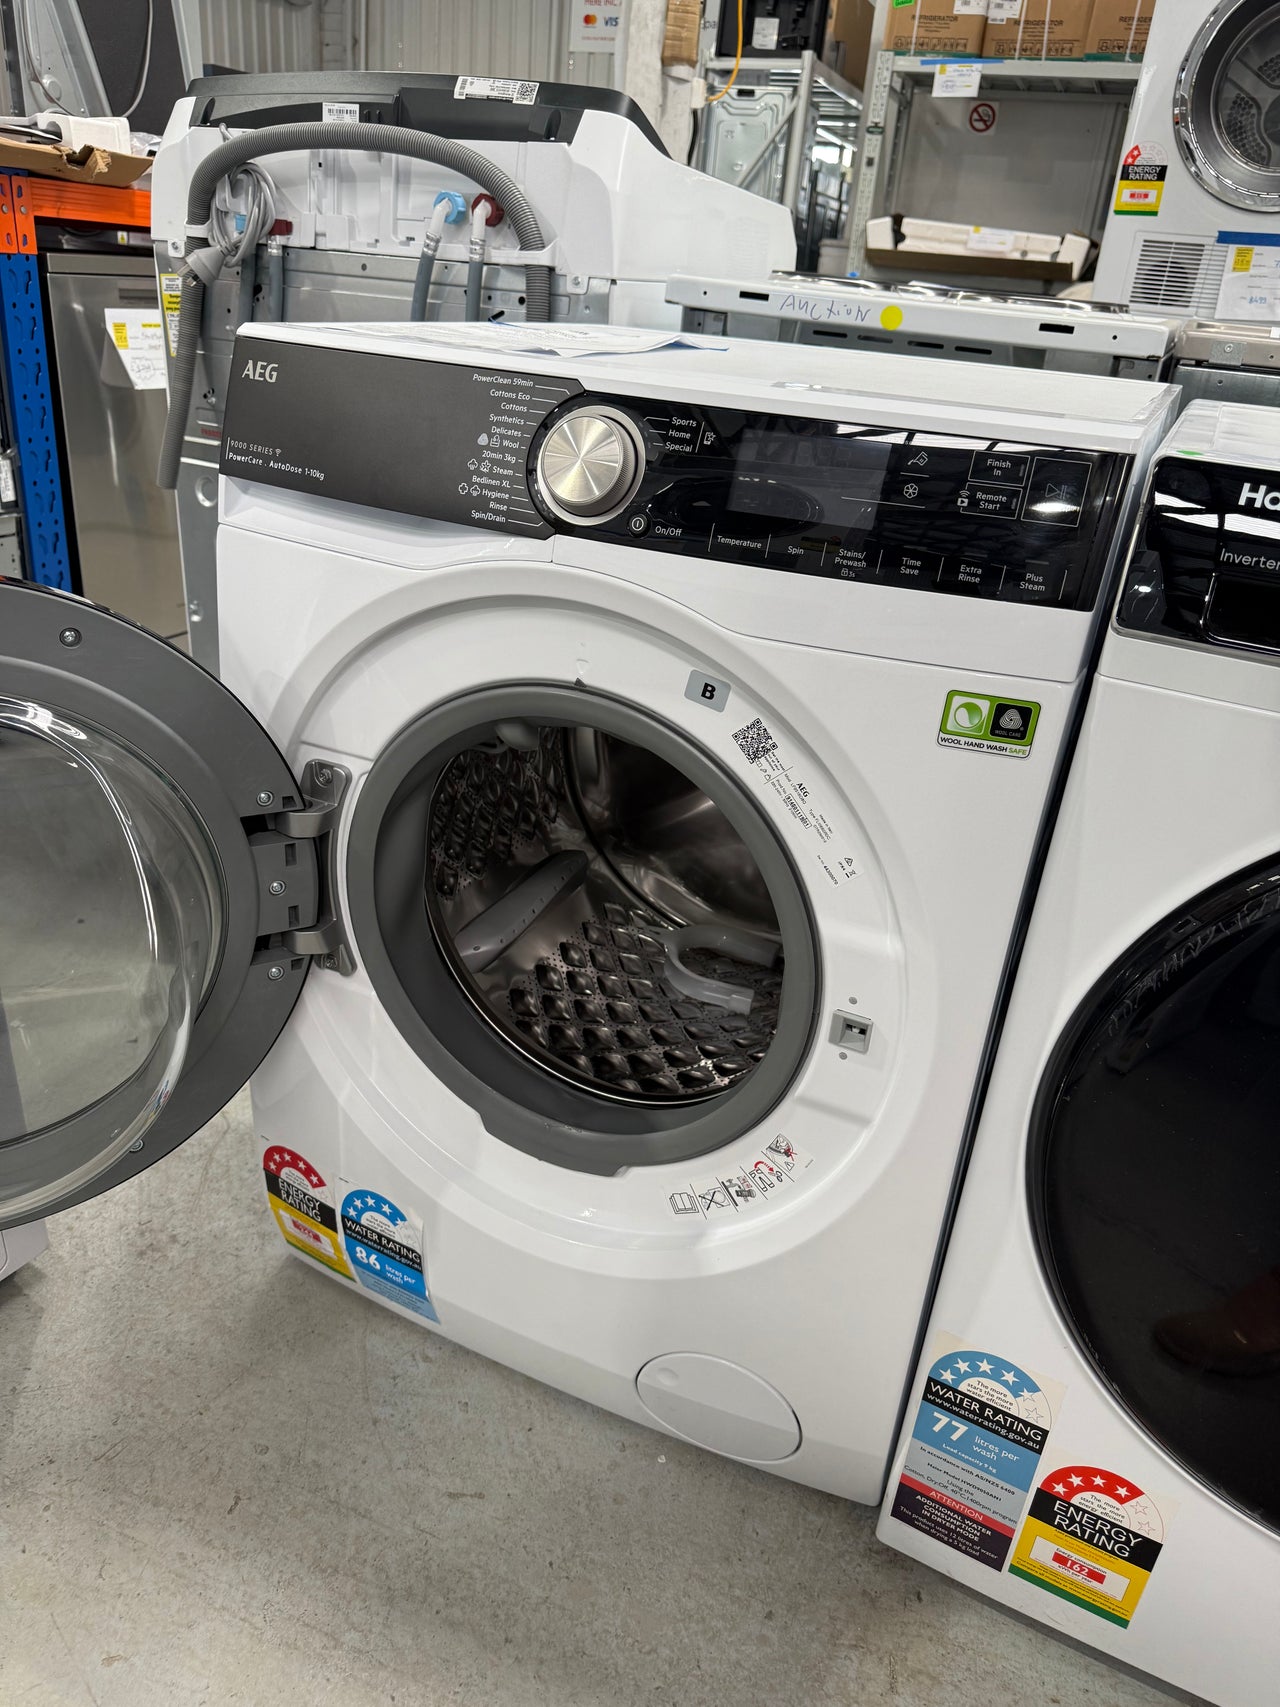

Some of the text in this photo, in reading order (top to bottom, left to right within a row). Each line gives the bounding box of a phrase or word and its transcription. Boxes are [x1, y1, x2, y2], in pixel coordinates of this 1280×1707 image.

[1128, 166, 1161, 174] ENERGY
[242, 360, 279, 383] AEG
[473, 374, 533, 387] PowerClean 59min
[490, 389, 531, 400] Cottons Eco
[501, 402, 527, 412] Cottons
[489, 414, 525, 425] Synthetics
[672, 416, 697, 427] Sports
[491, 426, 522, 437] Delicates
[668, 429, 691, 440] Home
[230, 440, 273, 455] 9000 SERIES
[502, 439, 519, 449] Wool
[665, 441, 693, 452] Special
[482, 450, 516, 464] 20min 3kg
[987, 458, 1012, 469] Finish
[229, 452, 325, 481] PowerCare AutoDose 1-10kg
[492, 466, 514, 476] Steam
[993, 468, 1002, 477] In
[472, 475, 511, 488] Bedlinen XL
[482, 486, 510, 500] Hygiene
[976, 491, 1008, 503] Remote
[489, 502, 508, 511] Rinse
[979, 500, 1000, 511] Start
[471, 510, 506, 523] Spin/Drain
[655, 525, 682, 537] On/Off
[717, 535, 762, 549] Temperature
[787, 545, 804, 556] Spin
[838, 548, 866, 560] Stains/
[901, 557, 922, 568] Time
[834, 557, 867, 569] Prewash
[900, 566, 920, 576] Save
[960, 564, 982, 575] Extra
[958, 573, 981, 584] Rinse
[1019, 581, 1046, 592] Steam
[1025, 573, 1043, 583] Plus
[701, 682, 716, 700] B
[940, 736, 1027, 756] WOOL HAND WASH SAFE
[795, 781, 810, 798] AEG
[278, 1178, 321, 1210] ENERGY
[281, 1190, 321, 1222] RATING
[344, 1218, 380, 1243] WATER
[382, 1237, 421, 1263] RATING
[355, 1246, 381, 1271] 86
[404, 1275, 416, 1285] per
[966, 1381, 1014, 1407] stars the more
[976, 1379, 1007, 1398] The more
[965, 1387, 1012, 1412] water efficient
[928, 1381, 1043, 1442] WATER RATING
[925, 1392, 1040, 1451] www.waterrating.gov.au
[933, 1411, 1019, 1464] 77 litres per
[941, 1442, 958, 1454] Load
[957, 1450, 983, 1466] capacity
[987, 1465, 997, 1474] kg
[971, 1443, 997, 1461] wash
[926, 1449, 959, 1469] accordance
[960, 1465, 974, 1476] with
[974, 1472, 999, 1488] AS/NZS
[999, 1484, 1015, 1496] 6400
[943, 1470, 960, 1481] Model
[946, 1479, 974, 1496] Using the
[928, 1489, 983, 1521] ATTENTION
[1079, 1495, 1125, 1519] stars the more
[1089, 1494, 1120, 1511] The more
[915, 1494, 992, 1536] ADDITIONAL WATER
[923, 1504, 980, 1536] CONSUMPTION
[991, 1508, 1017, 1525] program
[1077, 1500, 1123, 1523] energy efficient
[899, 1505, 911, 1515] This
[911, 1512, 935, 1528] product
[935, 1524, 948, 1534] uses
[956, 1534, 973, 1547] litres
[980, 1547, 998, 1560] water
[921, 1509, 979, 1542] IN DRYER MODE
[1052, 1499, 1143, 1549] ENERGY
[913, 1519, 930, 1530] when
[930, 1527, 948, 1541] drying
[958, 1542, 966, 1550] kg
[966, 1546, 979, 1556] load
[1053, 1514, 1131, 1559] RATING
[1055, 1547, 1074, 1559] Energy
[1073, 1556, 1107, 1574] consumption
[1065, 1559, 1089, 1576] 162
[1057, 1564, 1071, 1573] kWh
[1080, 1575, 1093, 1584] year
